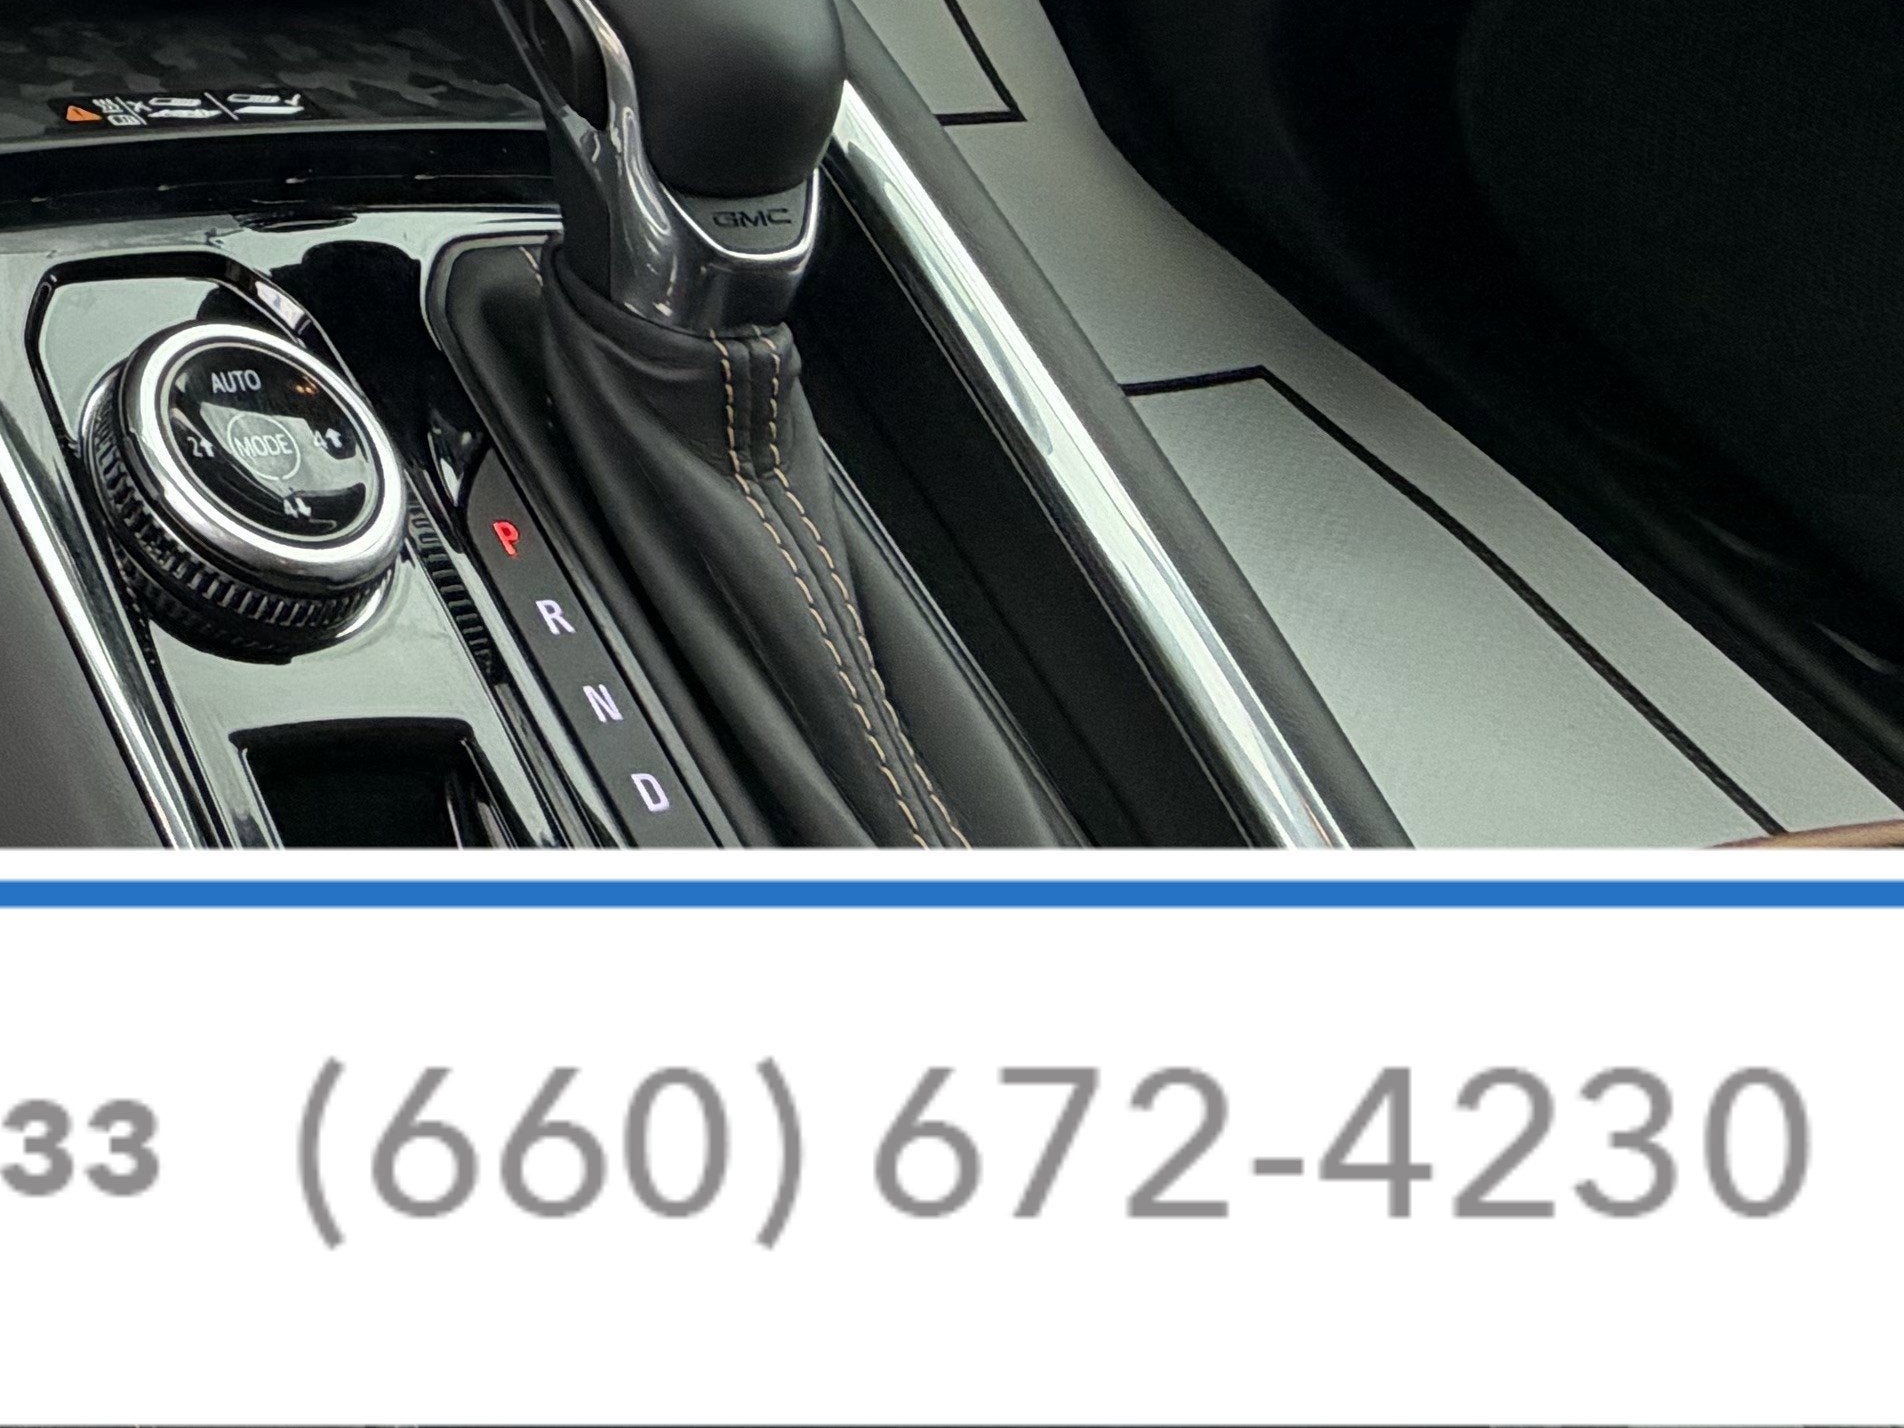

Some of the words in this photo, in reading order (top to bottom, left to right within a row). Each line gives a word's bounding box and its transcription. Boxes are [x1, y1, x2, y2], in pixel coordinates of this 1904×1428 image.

[712, 205, 793, 228] GMC
[211, 369, 262, 394] AUTO
[234, 433, 293, 459] MODE
[493, 520, 518, 558] P
[537, 599, 576, 636] R
[583, 683, 624, 724] N
[631, 772, 671, 813] D
